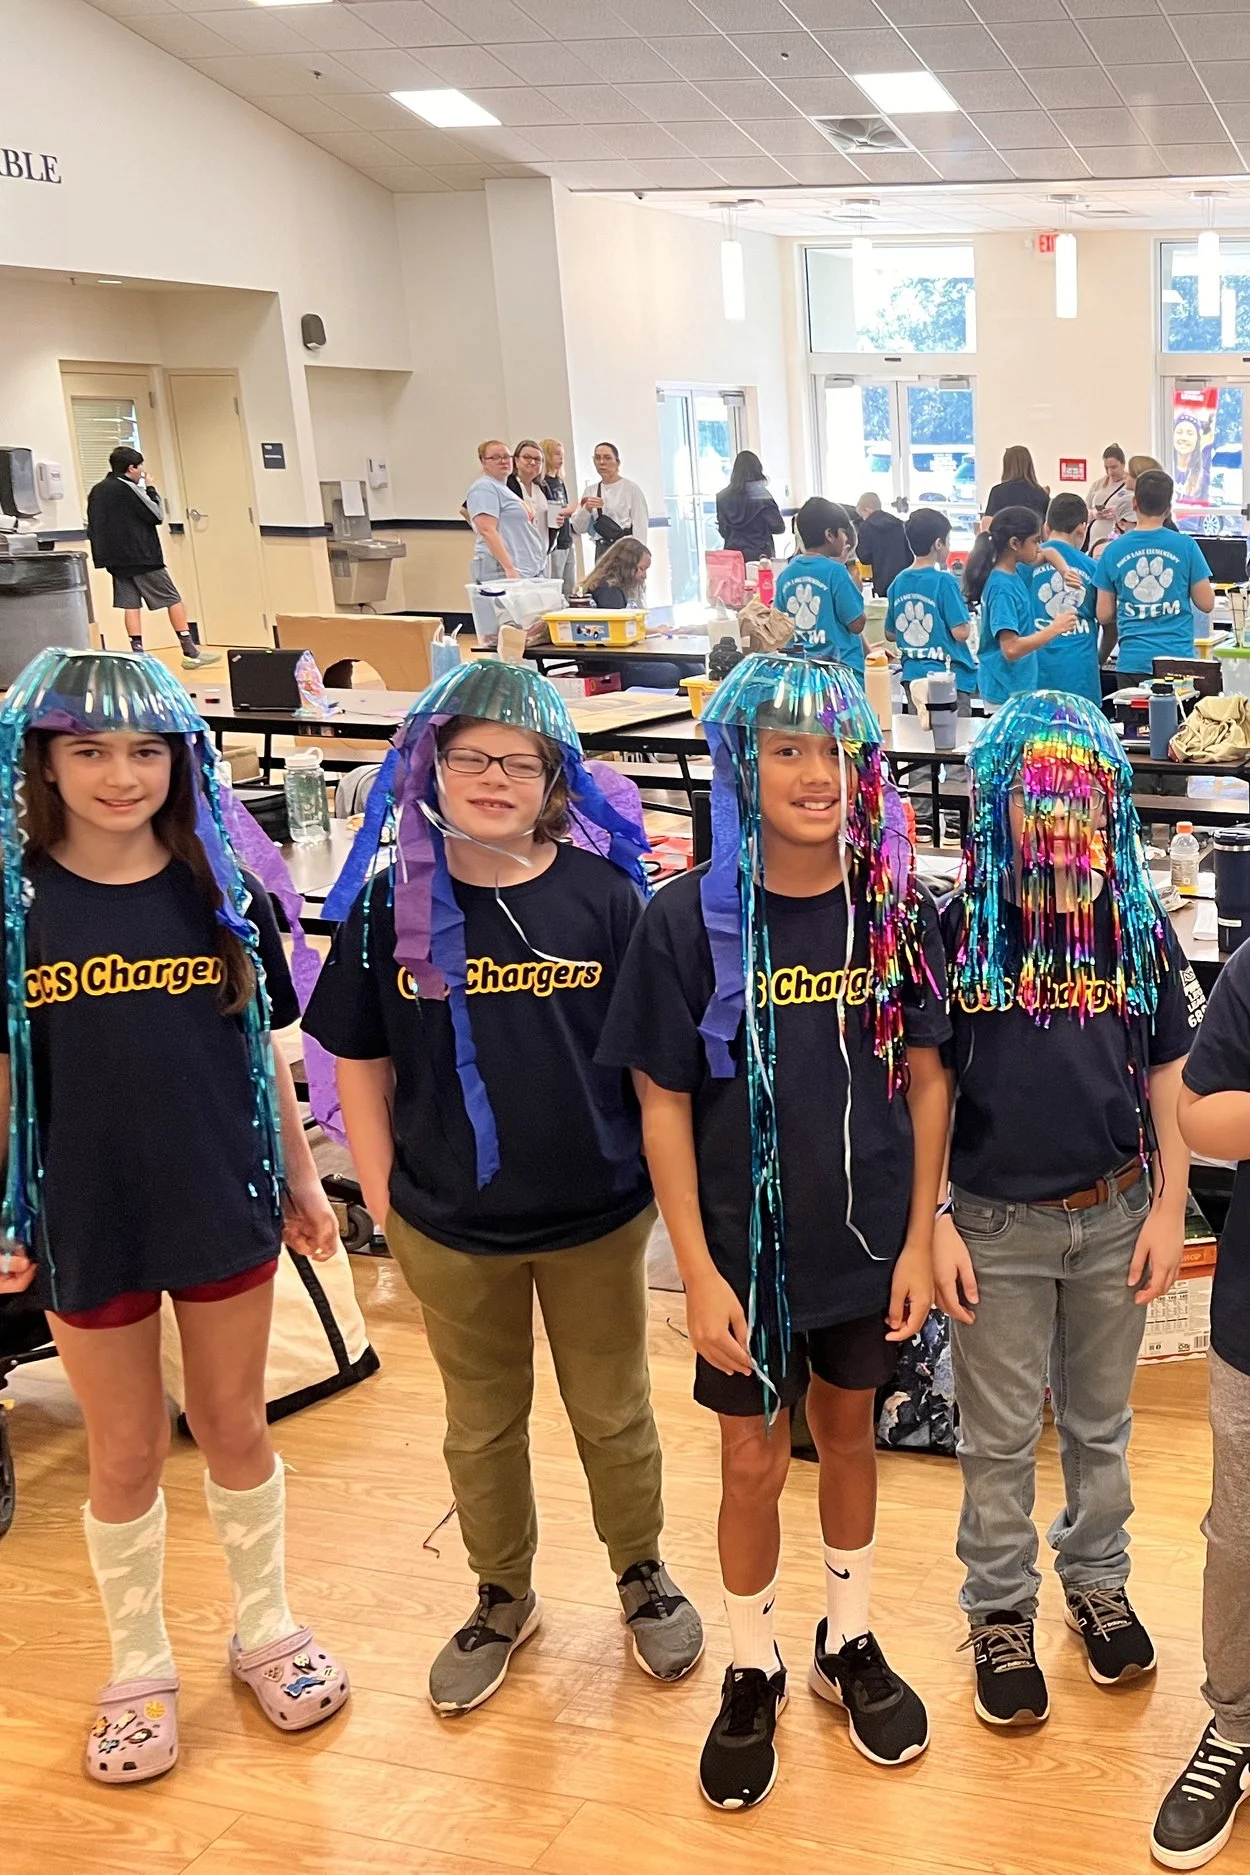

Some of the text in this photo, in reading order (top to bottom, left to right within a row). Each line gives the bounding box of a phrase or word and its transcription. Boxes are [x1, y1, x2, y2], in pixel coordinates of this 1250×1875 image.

[0, 148, 62, 184] BLE
[1039, 233, 1057, 253] EXI
[1124, 600, 1180, 619] STEM
[899, 646, 944, 660] TEM
[24, 953, 222, 1008] CCS Charger
[464, 957, 602, 997] Chargers
[771, 965, 874, 1006] Charg
